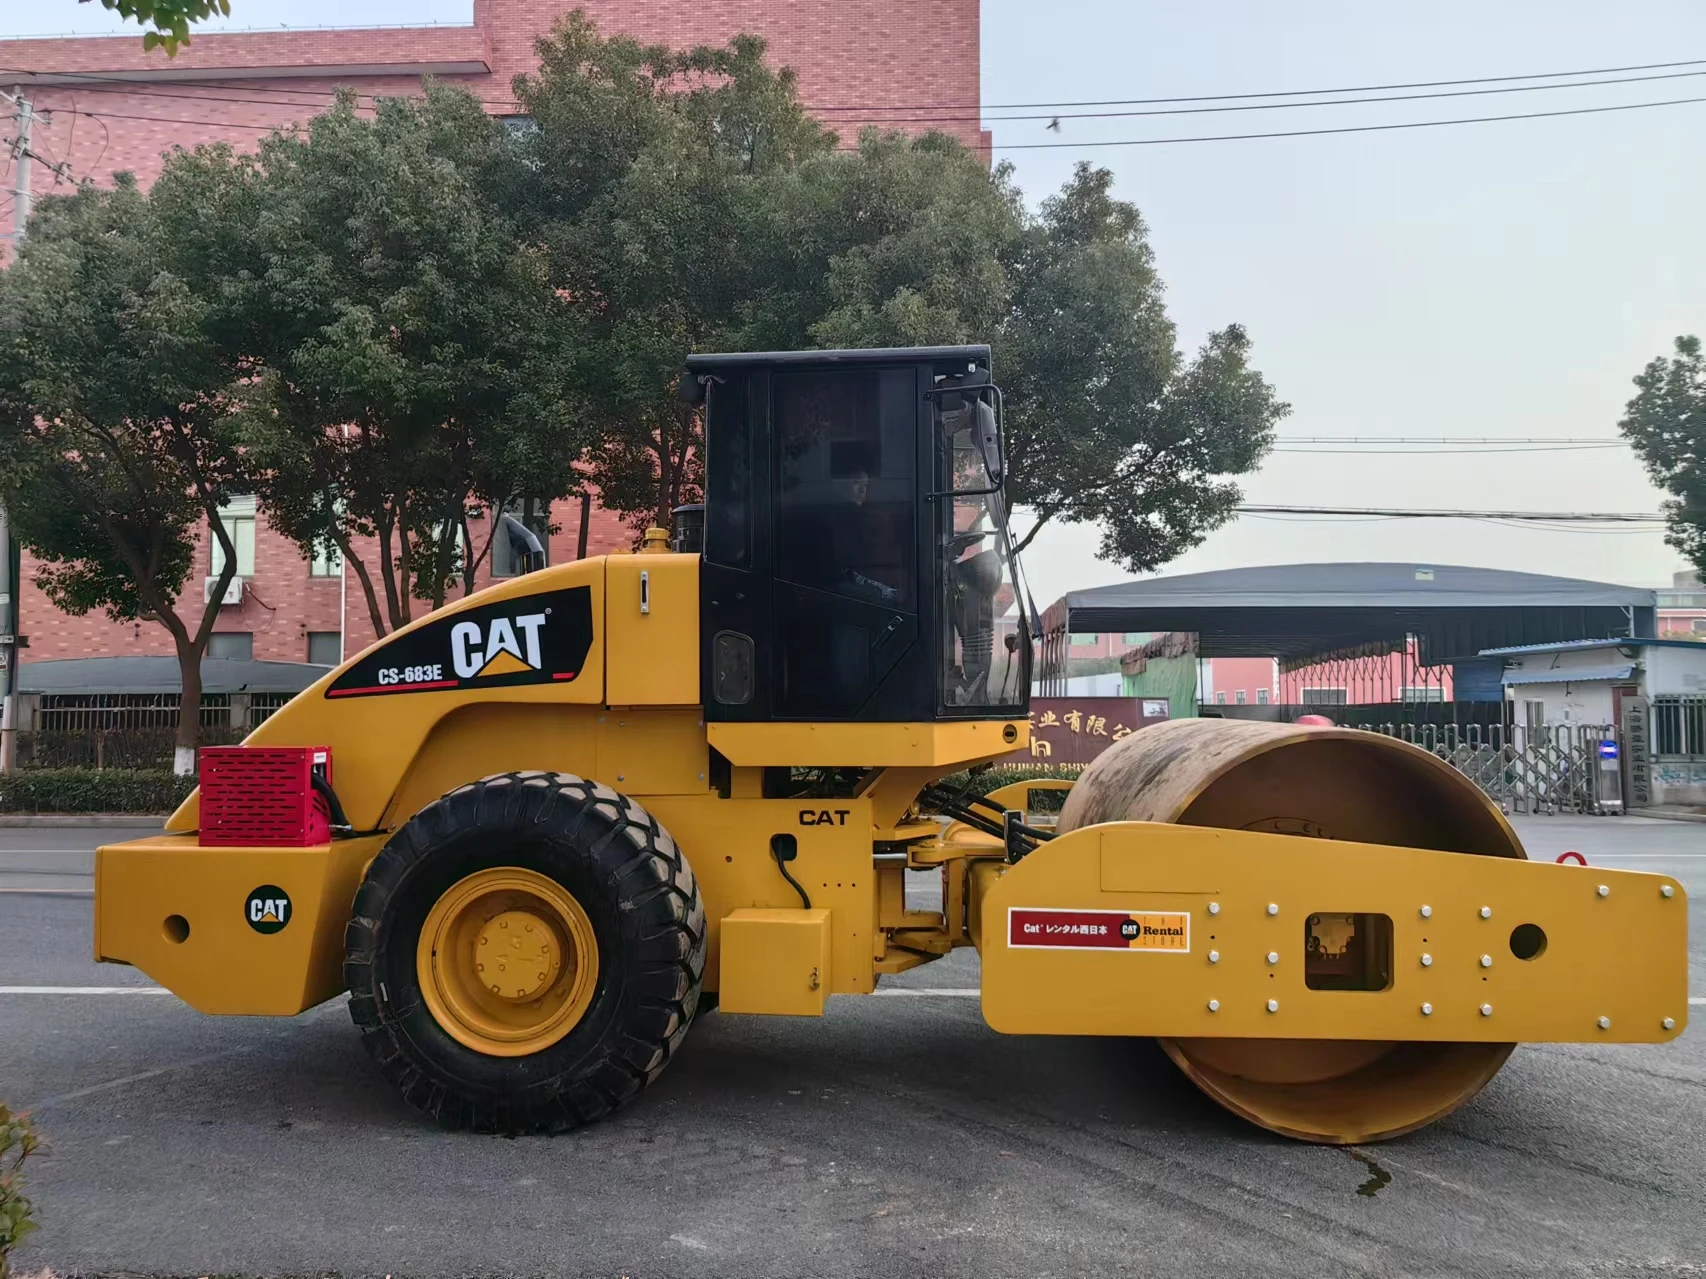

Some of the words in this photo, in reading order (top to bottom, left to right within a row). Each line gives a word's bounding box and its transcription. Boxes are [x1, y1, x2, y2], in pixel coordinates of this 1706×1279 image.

[378, 664, 443, 685] CS-683E
[799, 810, 850, 825] CAT
[250, 899, 288, 922] CAT
[1046, 924, 1108, 935] レンタル西日本
[1121, 924, 1138, 935] CAT
[1143, 926, 1184, 936] Rental
